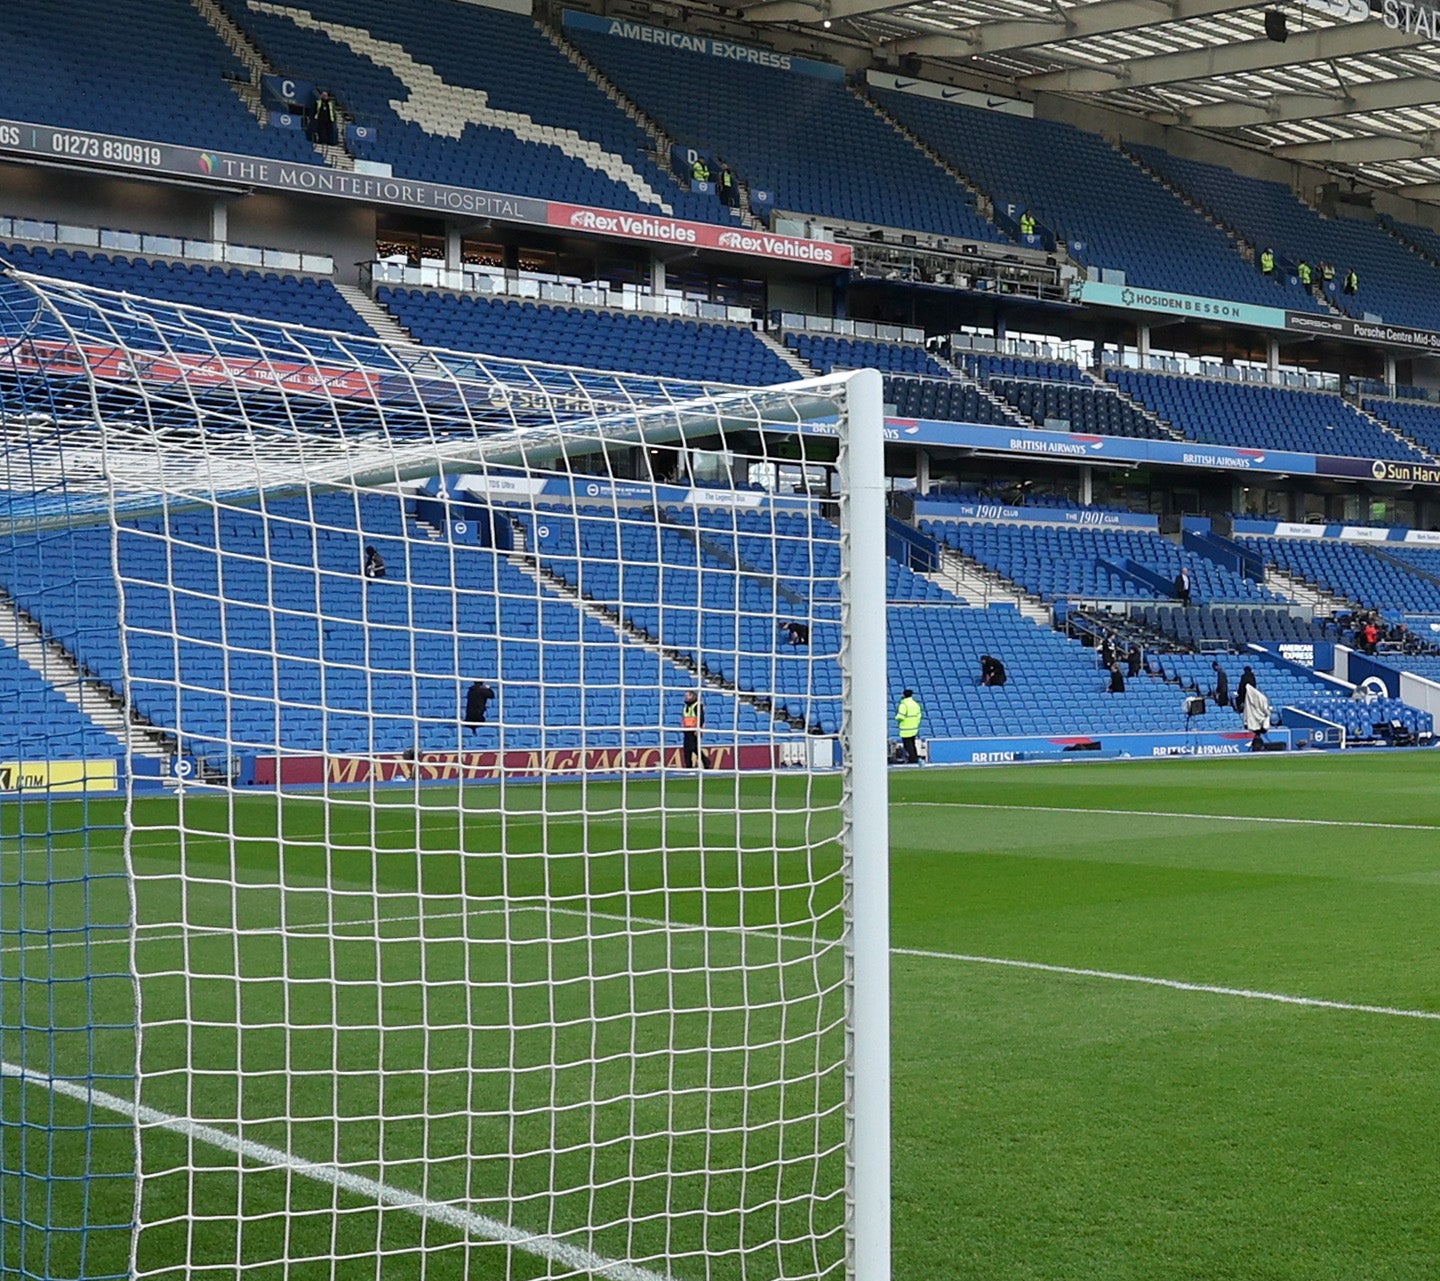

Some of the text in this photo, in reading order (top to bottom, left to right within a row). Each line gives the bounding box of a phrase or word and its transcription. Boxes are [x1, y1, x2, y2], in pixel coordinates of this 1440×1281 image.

[609, 20, 792, 71] AMERICAN EXPRESS
[282, 80, 296, 98] C
[52, 133, 99, 158] 01273
[103, 139, 161, 166] 830919
[687, 149, 699, 164] D
[223, 159, 525, 219] THE MONTEFIORE HOSPITAL
[583, 212, 696, 243] Rex Vehicles
[730, 231, 833, 263] Rex Vehicles
[1136, 293, 1240, 318] HOSIDEN BESSON
[1290, 316, 1342, 332] PORSCHE
[1353, 324, 1386, 339] Porsche
[1386, 327, 1412, 343] Centre
[1010, 438, 1087, 456] BRITISH AIRWAYS
[1183, 453, 1250, 469] BRITISH AIRWAYS
[1387, 464, 1410, 480] Sun
[975, 504, 1003, 519] 1901
[1078, 511, 1105, 525] 1901
[1278, 644, 1314, 652] AMERICAN
[326, 751, 516, 784] MANSELL
